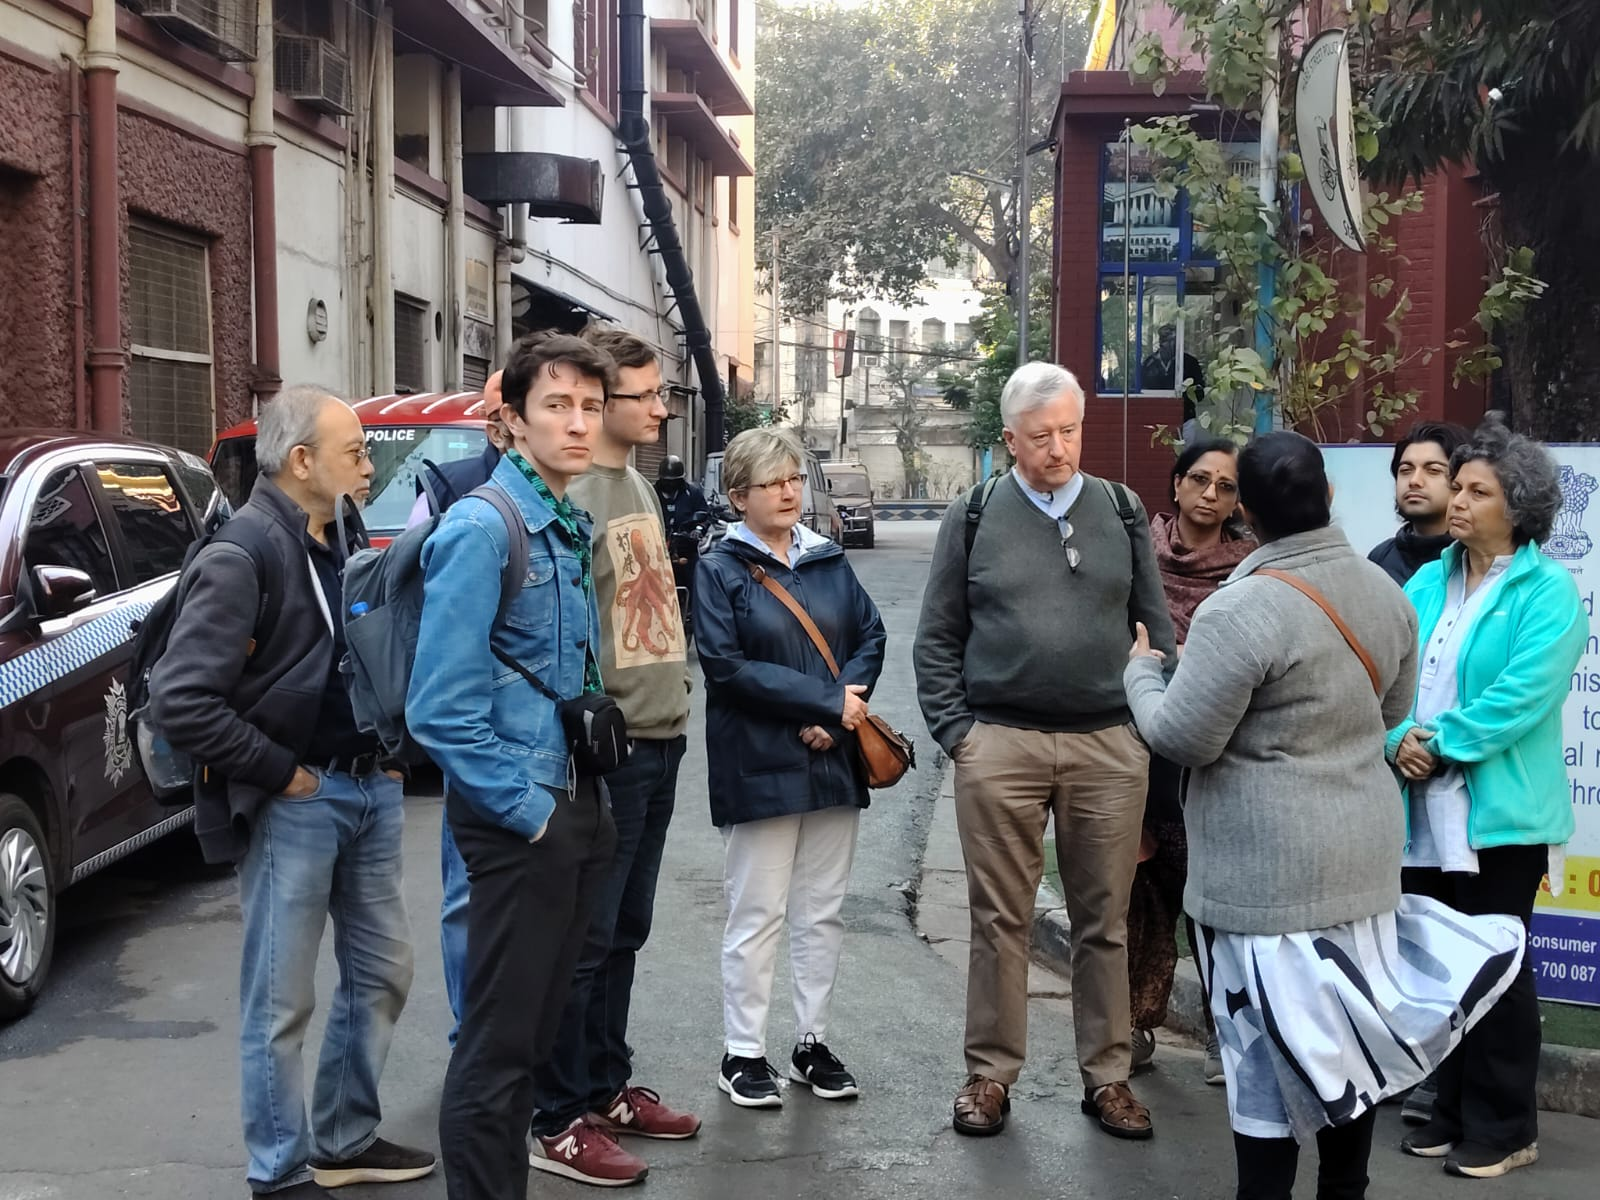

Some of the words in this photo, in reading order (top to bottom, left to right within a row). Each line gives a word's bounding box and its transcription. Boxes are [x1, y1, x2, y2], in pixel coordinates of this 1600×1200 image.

[365, 429, 415, 441] POLICE
[1541, 961, 1567, 979] 700
[1570, 964, 1597, 983] 087
